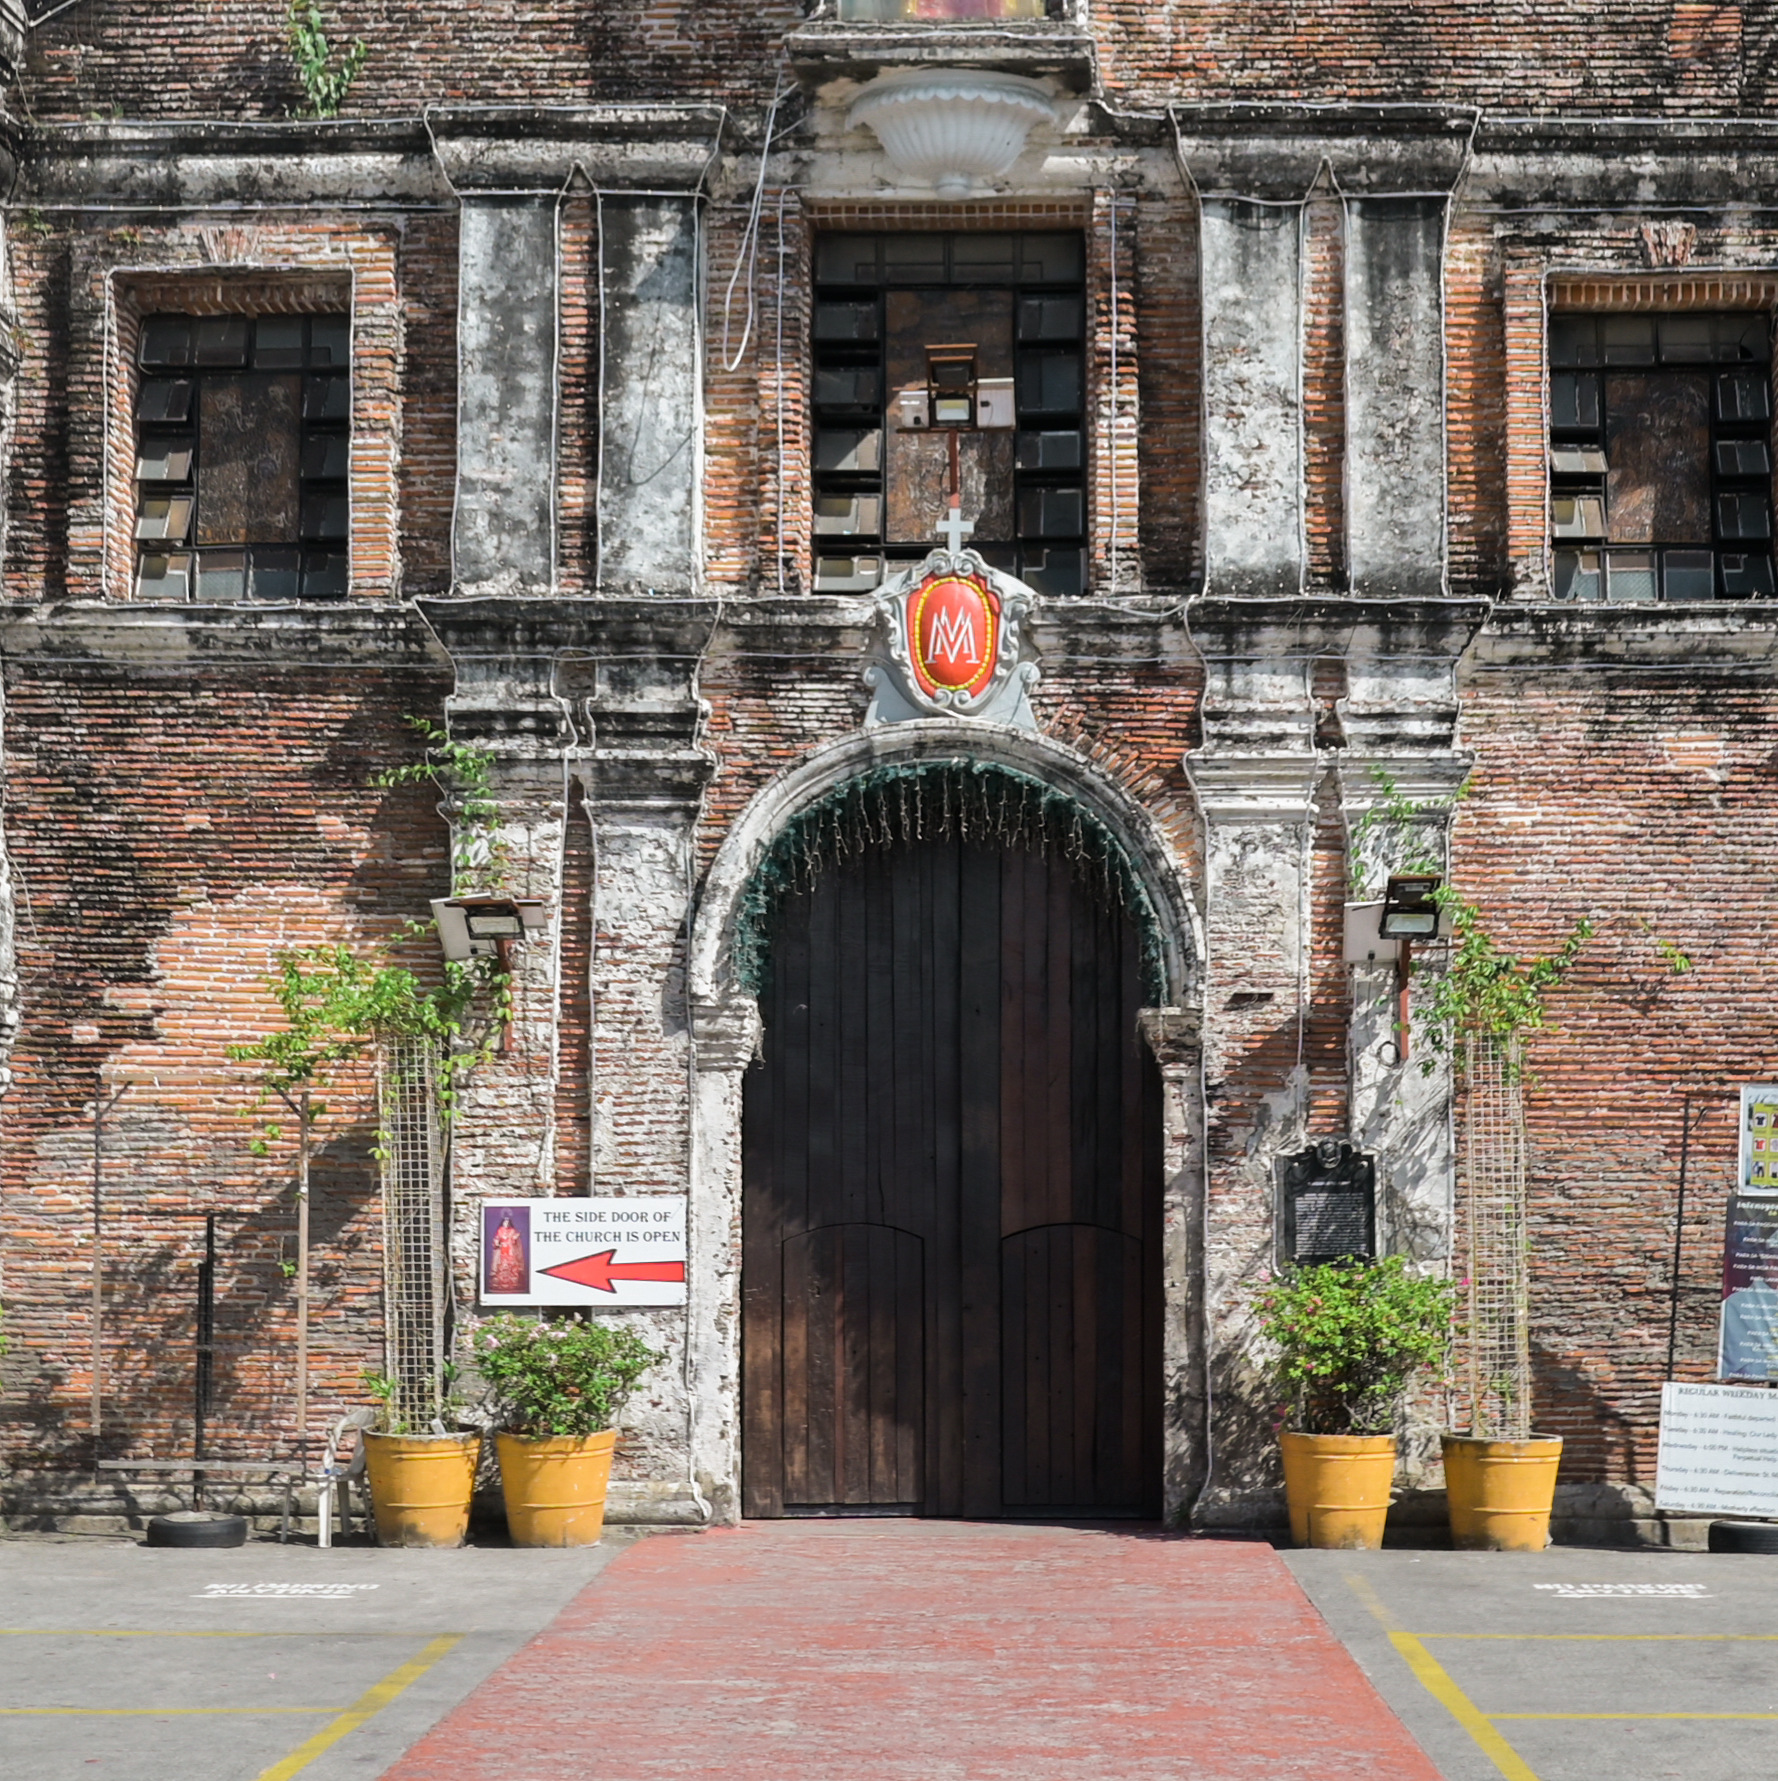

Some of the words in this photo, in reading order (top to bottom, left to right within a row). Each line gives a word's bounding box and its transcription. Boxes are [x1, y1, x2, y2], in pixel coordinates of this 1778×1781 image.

[543, 1211, 571, 1222] THE
[575, 1211, 607, 1222] SIDE
[611, 1211, 649, 1222] DOOR
[653, 1211, 671, 1222] OF
[534, 1231, 562, 1242] THE
[566, 1231, 622, 1242] CHURCH
[626, 1231, 639, 1242] IS
[643, 1231, 680, 1242] OPEN
[1678, 1387, 1719, 1397] REGULAR
[1723, 1390, 1765, 1399] WEEKDAY
